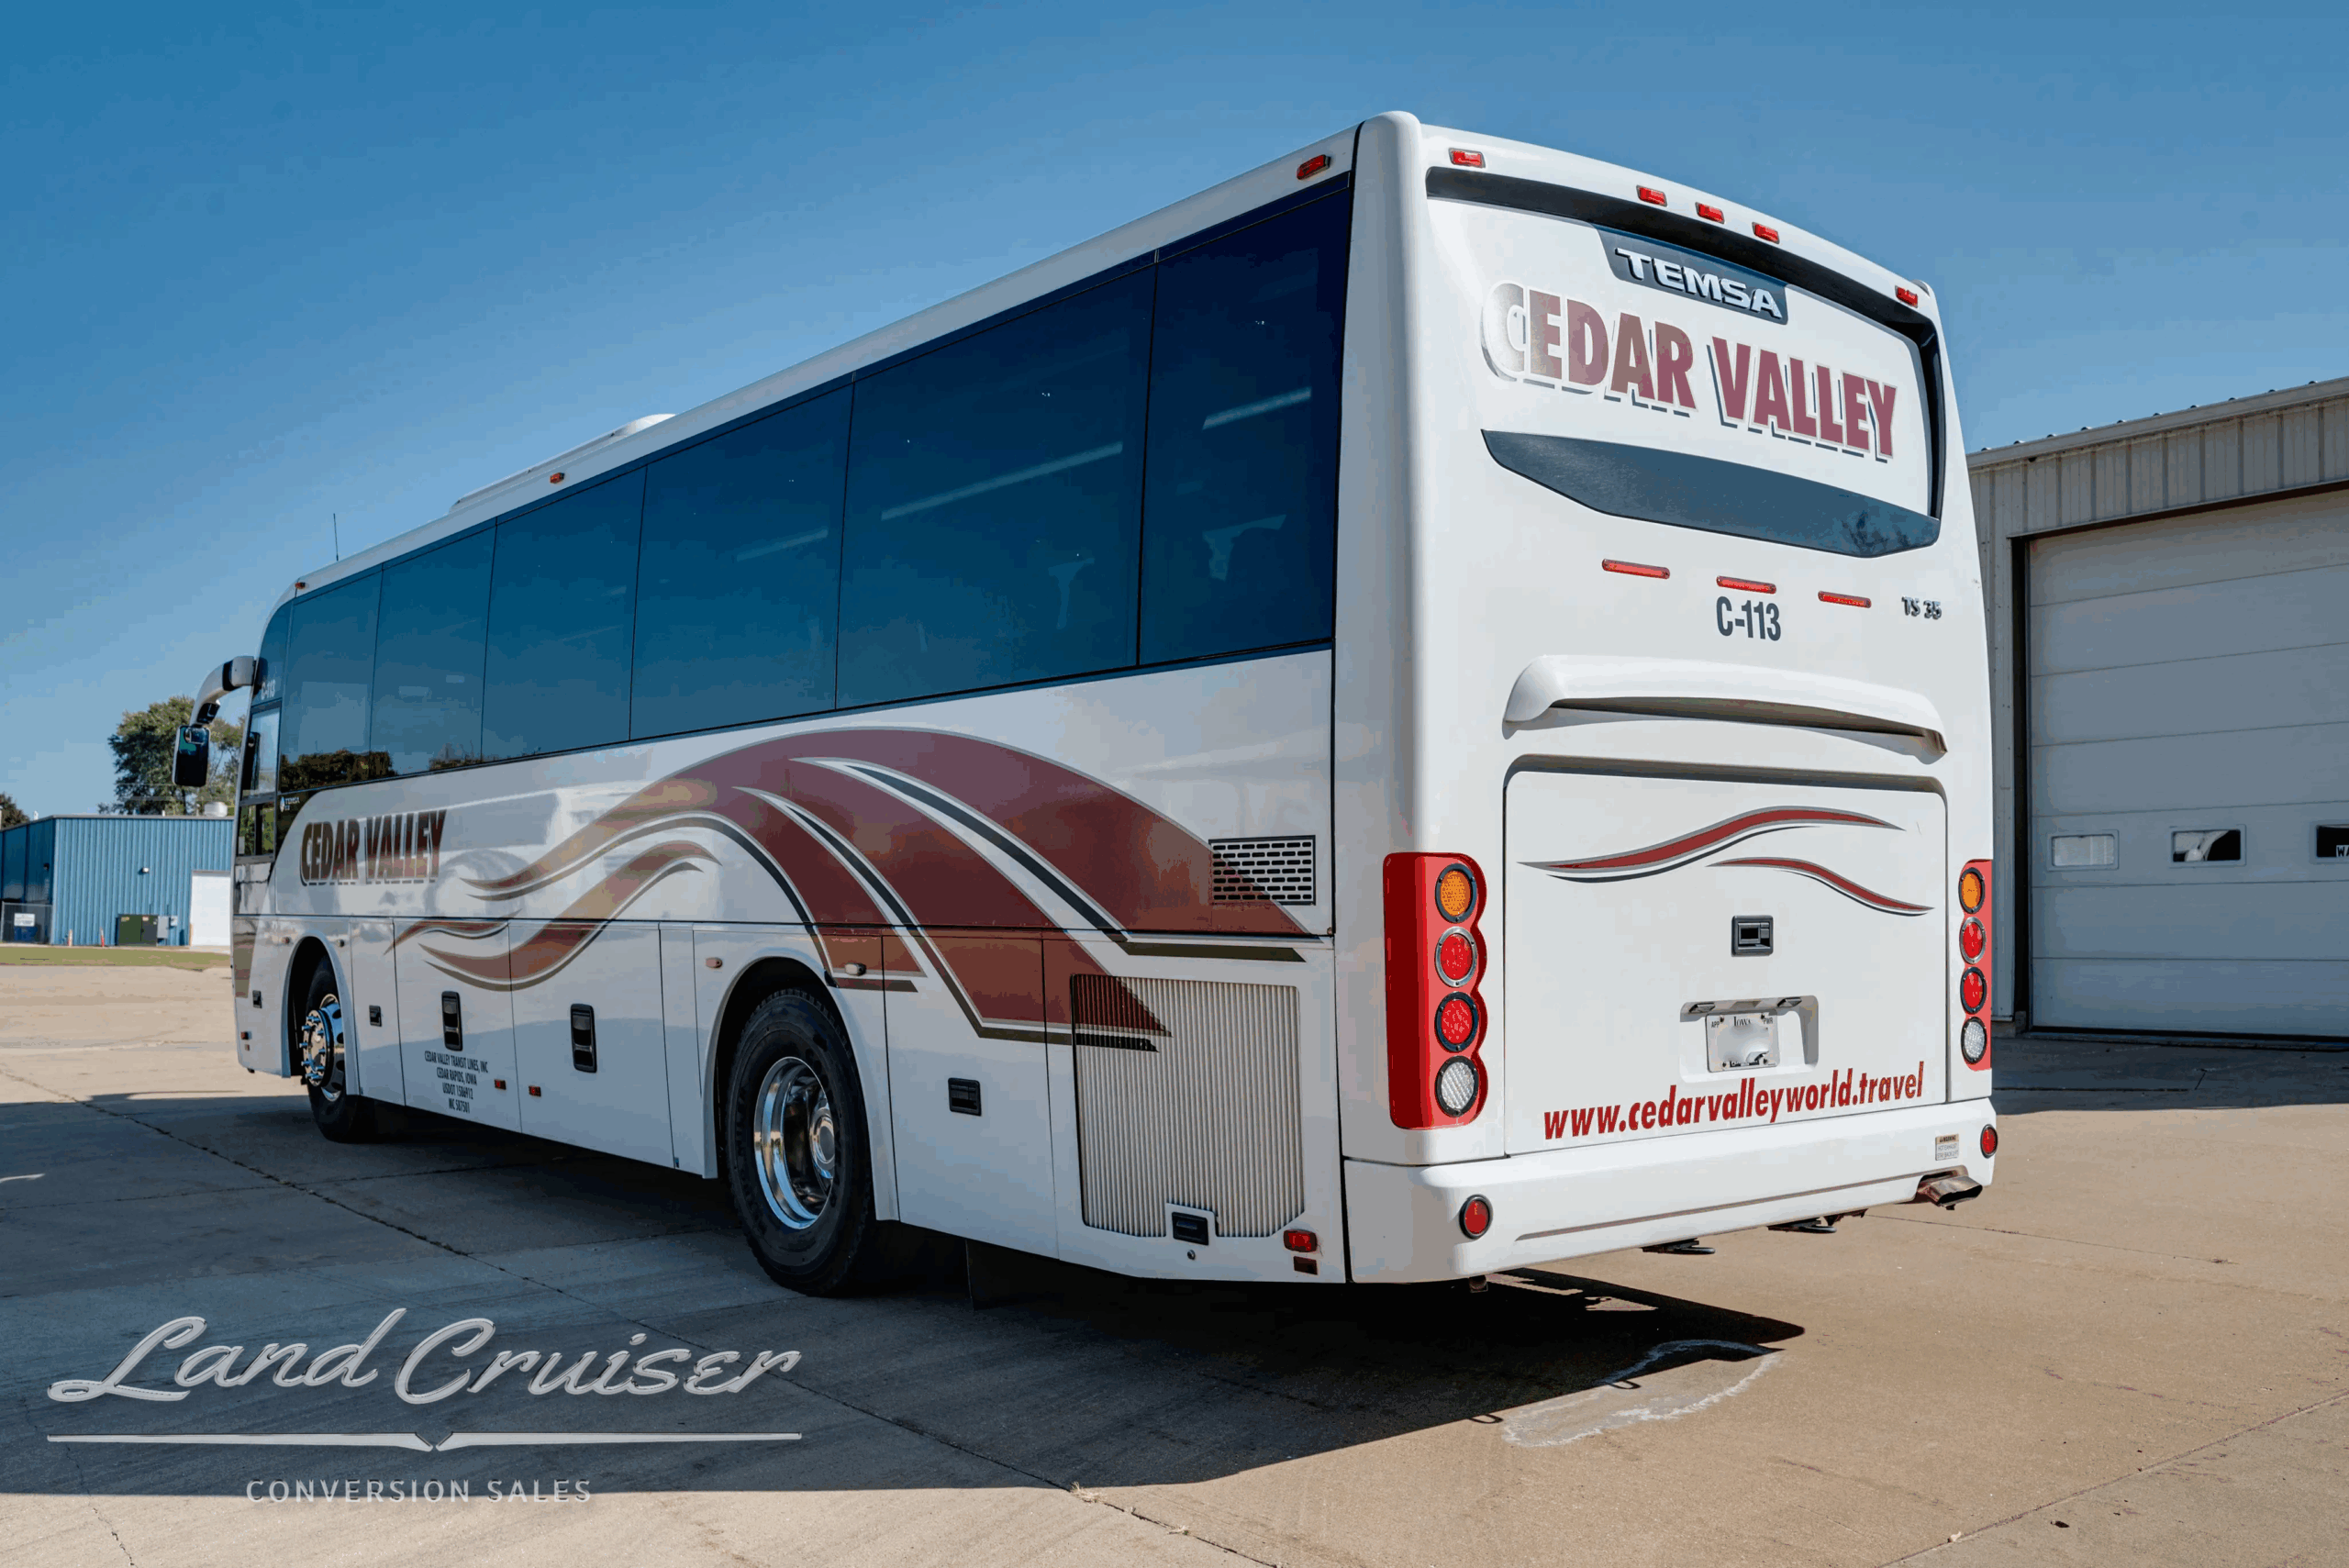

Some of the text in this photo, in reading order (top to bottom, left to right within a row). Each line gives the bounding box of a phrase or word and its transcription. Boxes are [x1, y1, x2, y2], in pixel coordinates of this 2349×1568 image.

[1615, 248, 1783, 319] TEMSA
[1481, 280, 1898, 463] CEDAR VALLEY
[1716, 595, 1782, 641] C-113
[1901, 595, 1943, 620] TS 35
[300, 808, 447, 886] CEDAR VALLEY
[424, 1051, 437, 1063] CEDAR
[437, 1052, 450, 1065] VALLEY
[451, 1054, 466, 1069] TRANSIT
[437, 1066, 449, 1080] CEDAR
[465, 1073, 477, 1086] IOWA
[442, 1082, 455, 1095] USDOT
[1543, 1061, 1925, 1140] www.cedarvalleyworld.travel
